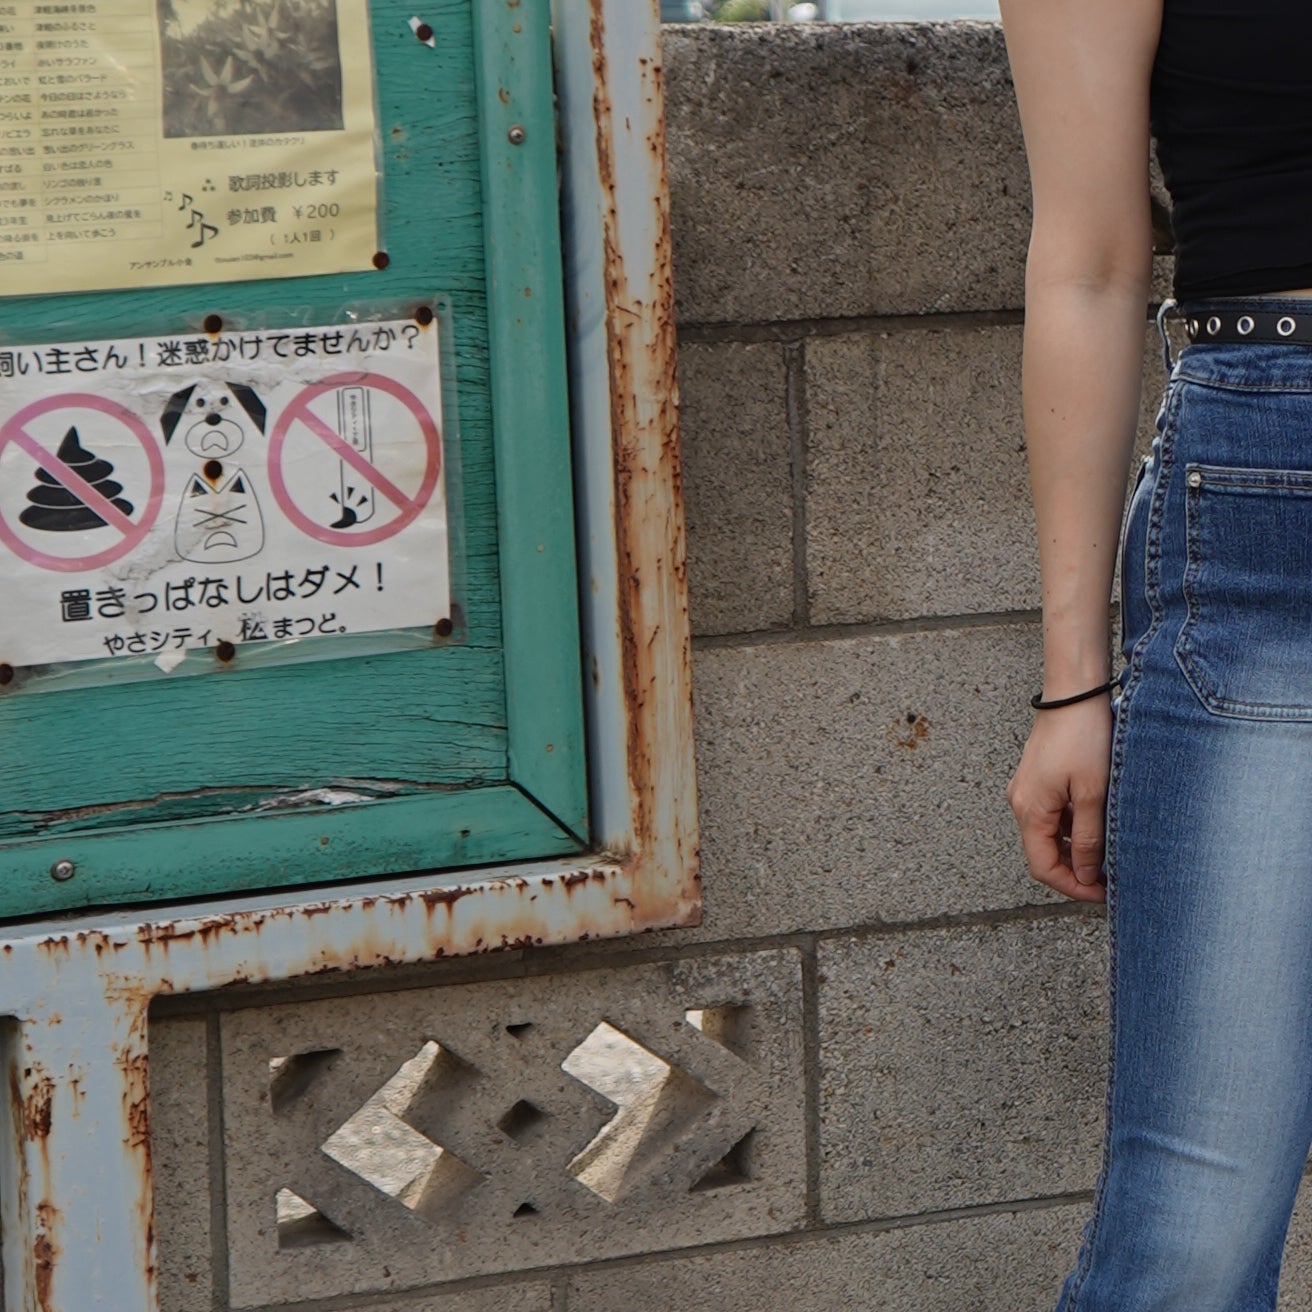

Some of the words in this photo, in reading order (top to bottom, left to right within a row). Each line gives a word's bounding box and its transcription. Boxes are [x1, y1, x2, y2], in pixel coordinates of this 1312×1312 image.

[228, 170, 339, 192] 歌詞投影します
[226, 206, 278, 226] 参加費
